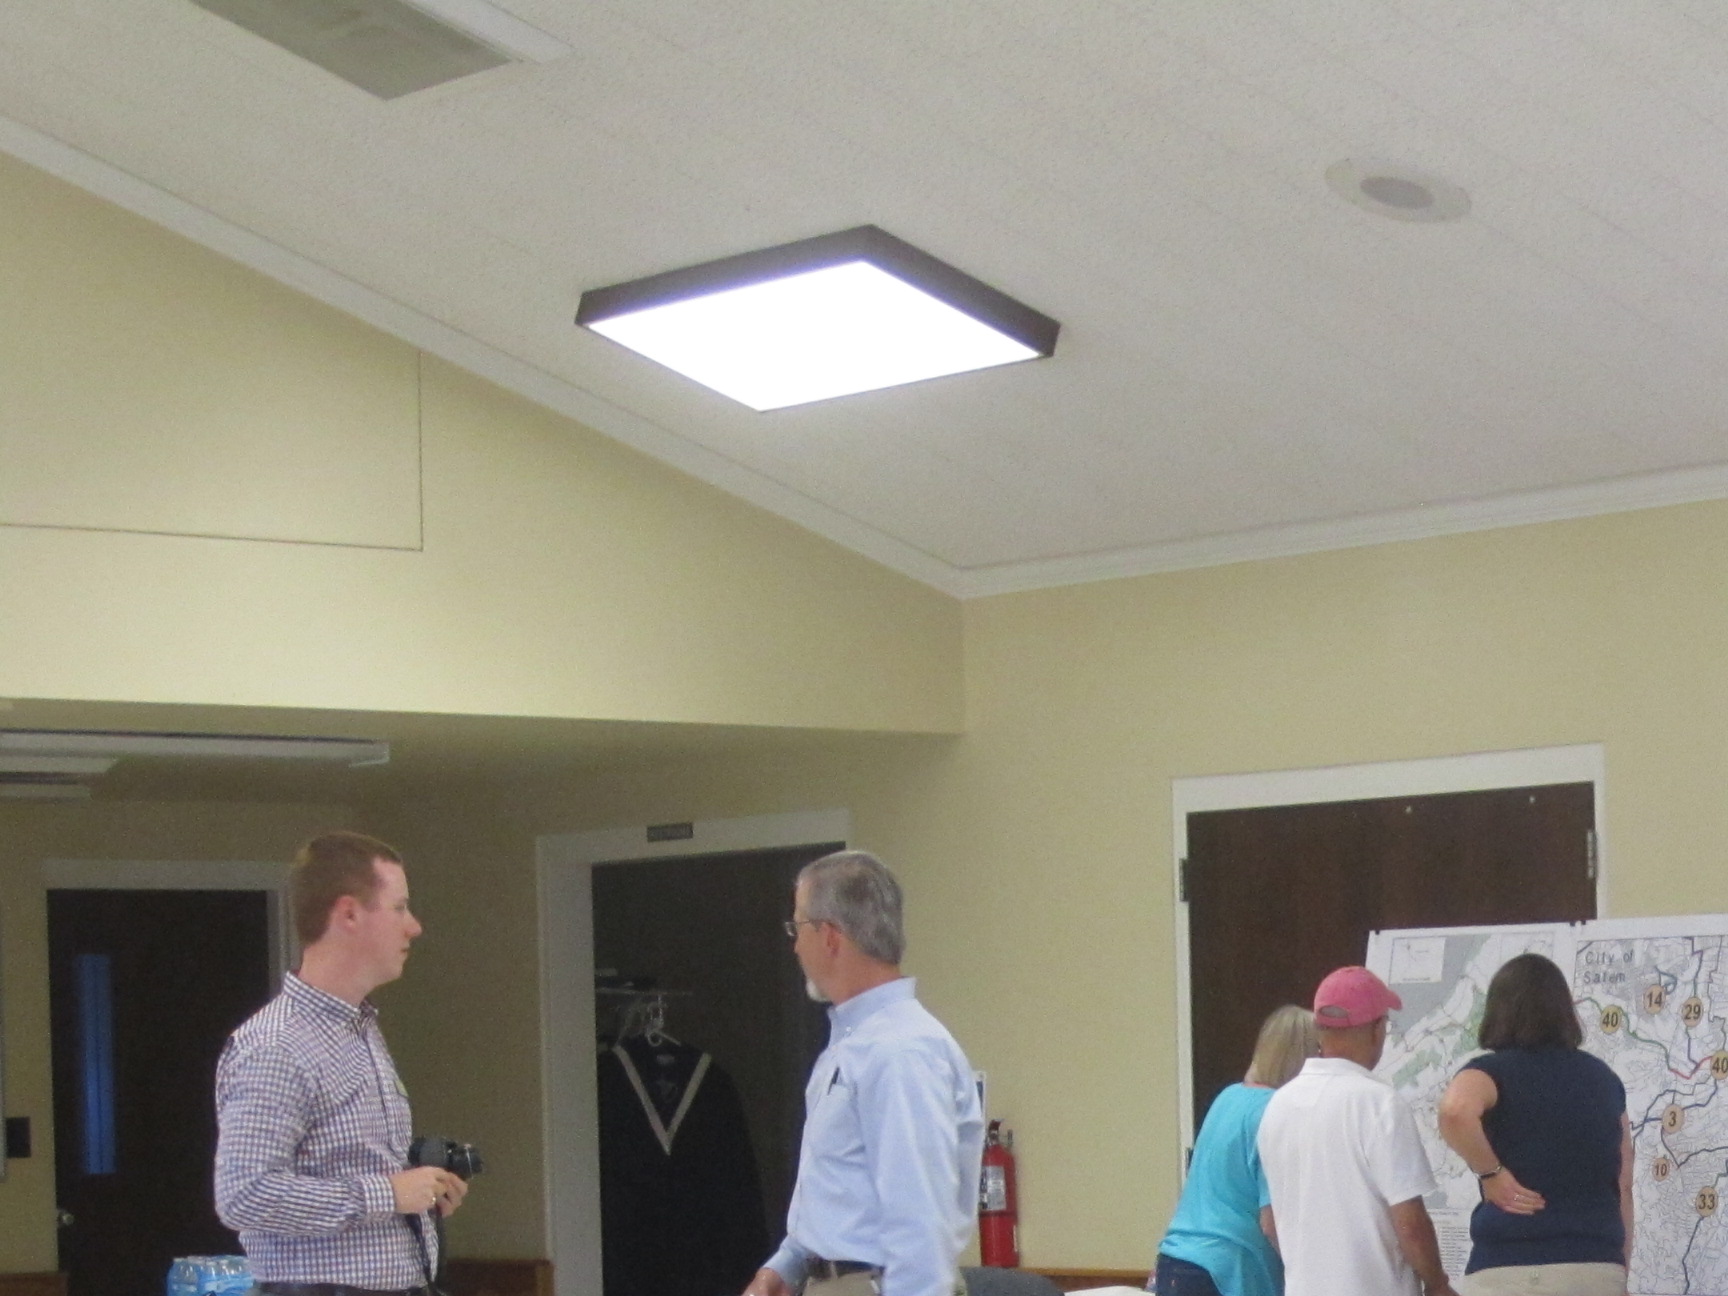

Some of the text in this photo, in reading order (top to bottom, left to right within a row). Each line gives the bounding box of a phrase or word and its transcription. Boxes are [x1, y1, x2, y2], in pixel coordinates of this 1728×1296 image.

[1646, 992, 1663, 1008] 14
[1601, 1011, 1620, 1028] 40
[1683, 1003, 1702, 1020] 29
[1667, 1111, 1678, 1128] 3
[1654, 1162, 1669, 1177] 10
[1699, 1193, 1716, 1210] 33
